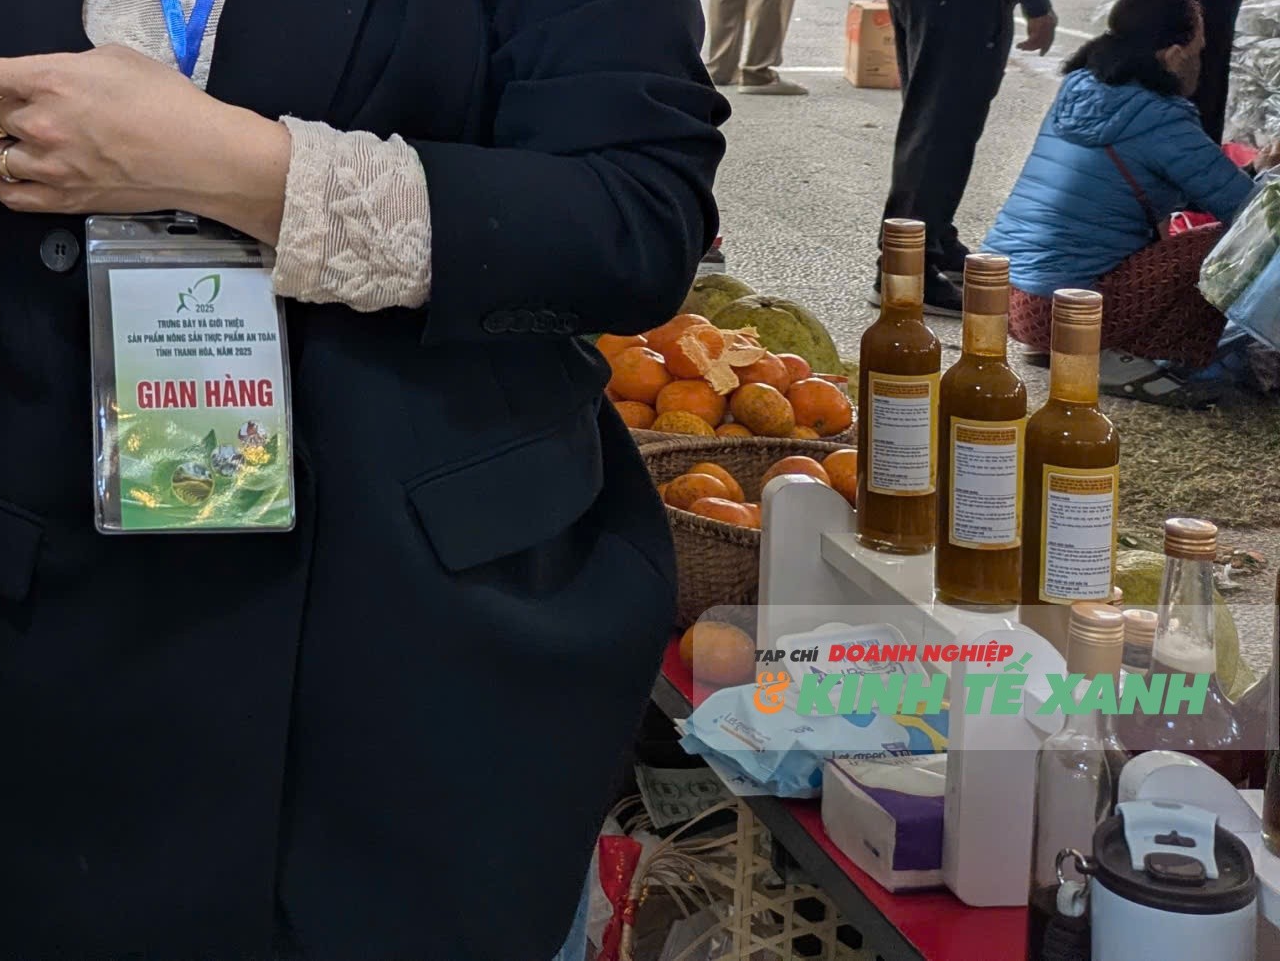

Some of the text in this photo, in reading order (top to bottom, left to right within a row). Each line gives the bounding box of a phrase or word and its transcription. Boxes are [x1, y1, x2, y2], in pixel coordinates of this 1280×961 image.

[195, 303, 215, 313] 2025
[157, 318, 181, 328] TRƯNG
[182, 317, 197, 328] BÀY
[198, 317, 208, 328] VÀ
[224, 317, 244, 329] THIỆU
[127, 330, 277, 344] SẢN PHẨM NÔNG SẢN THỰC PHẨM AN TOÀN
[155, 344, 172, 357] TỈNH
[174, 347, 197, 356] THANH
[216, 345, 233, 356] NĂM
[235, 346, 252, 356] 2025
[137, 374, 274, 409] GIAN HÀNG
